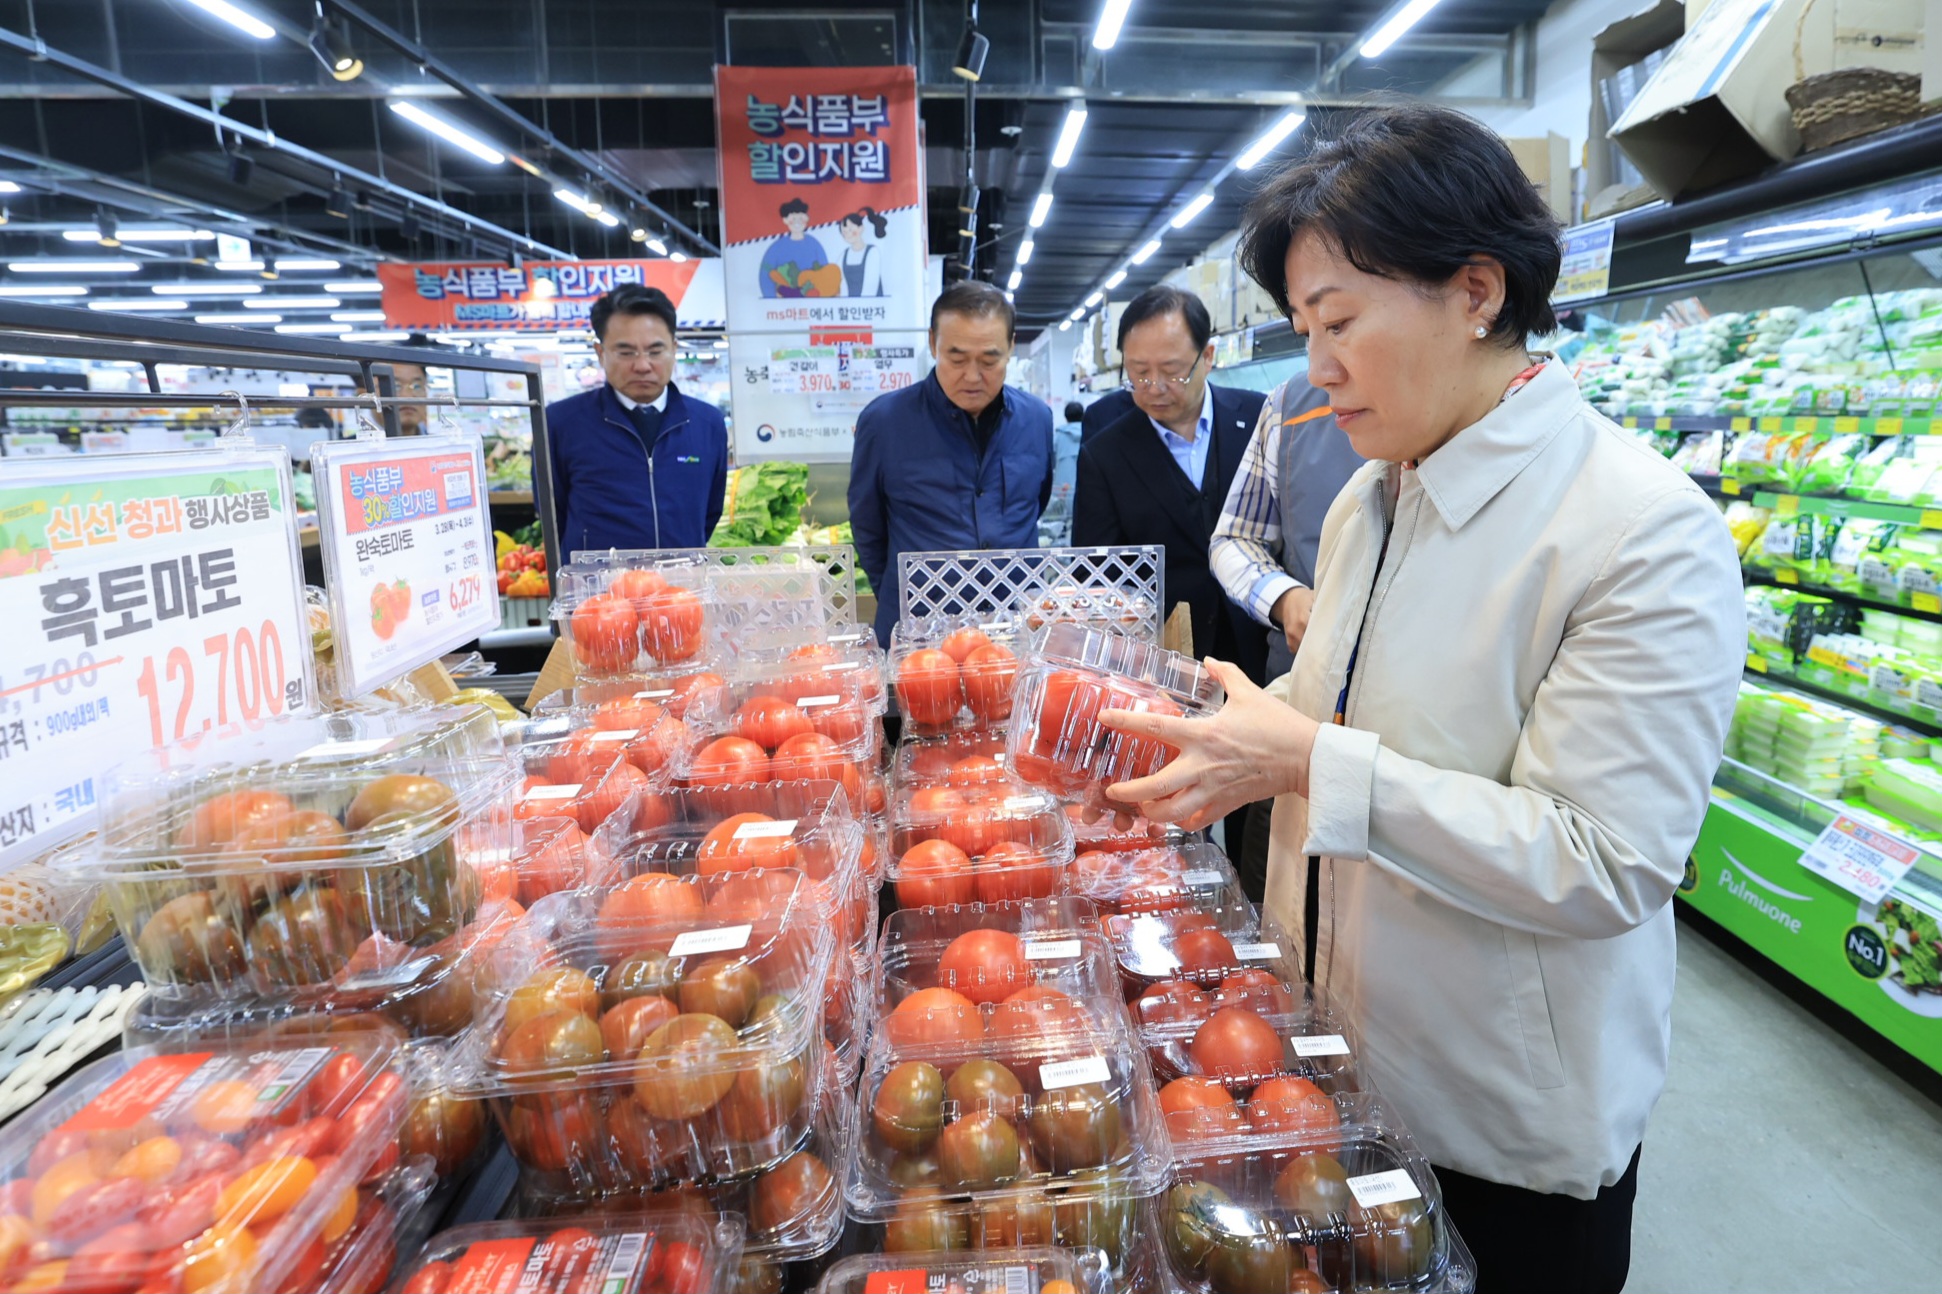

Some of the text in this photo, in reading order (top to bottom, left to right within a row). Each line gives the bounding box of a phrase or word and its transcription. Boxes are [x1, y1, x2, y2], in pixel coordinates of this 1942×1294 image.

[747, 94, 890, 137] 농식품부
[748, 139, 891, 184] 할인지원
[414, 265, 528, 300] 농식품부
[767, 306, 886, 321] ms마트에서 할인받자
[349, 467, 402, 497] 농식품부
[48, 491, 271, 550] 신선 청과 행사상품
[356, 530, 415, 561] 완숙토마토
[40, 548, 242, 648] 흑토마토
[449, 575, 482, 611] 6,279
[1717, 869, 1802, 934] Pulmuone
[1848, 933, 1884, 967] No.1
